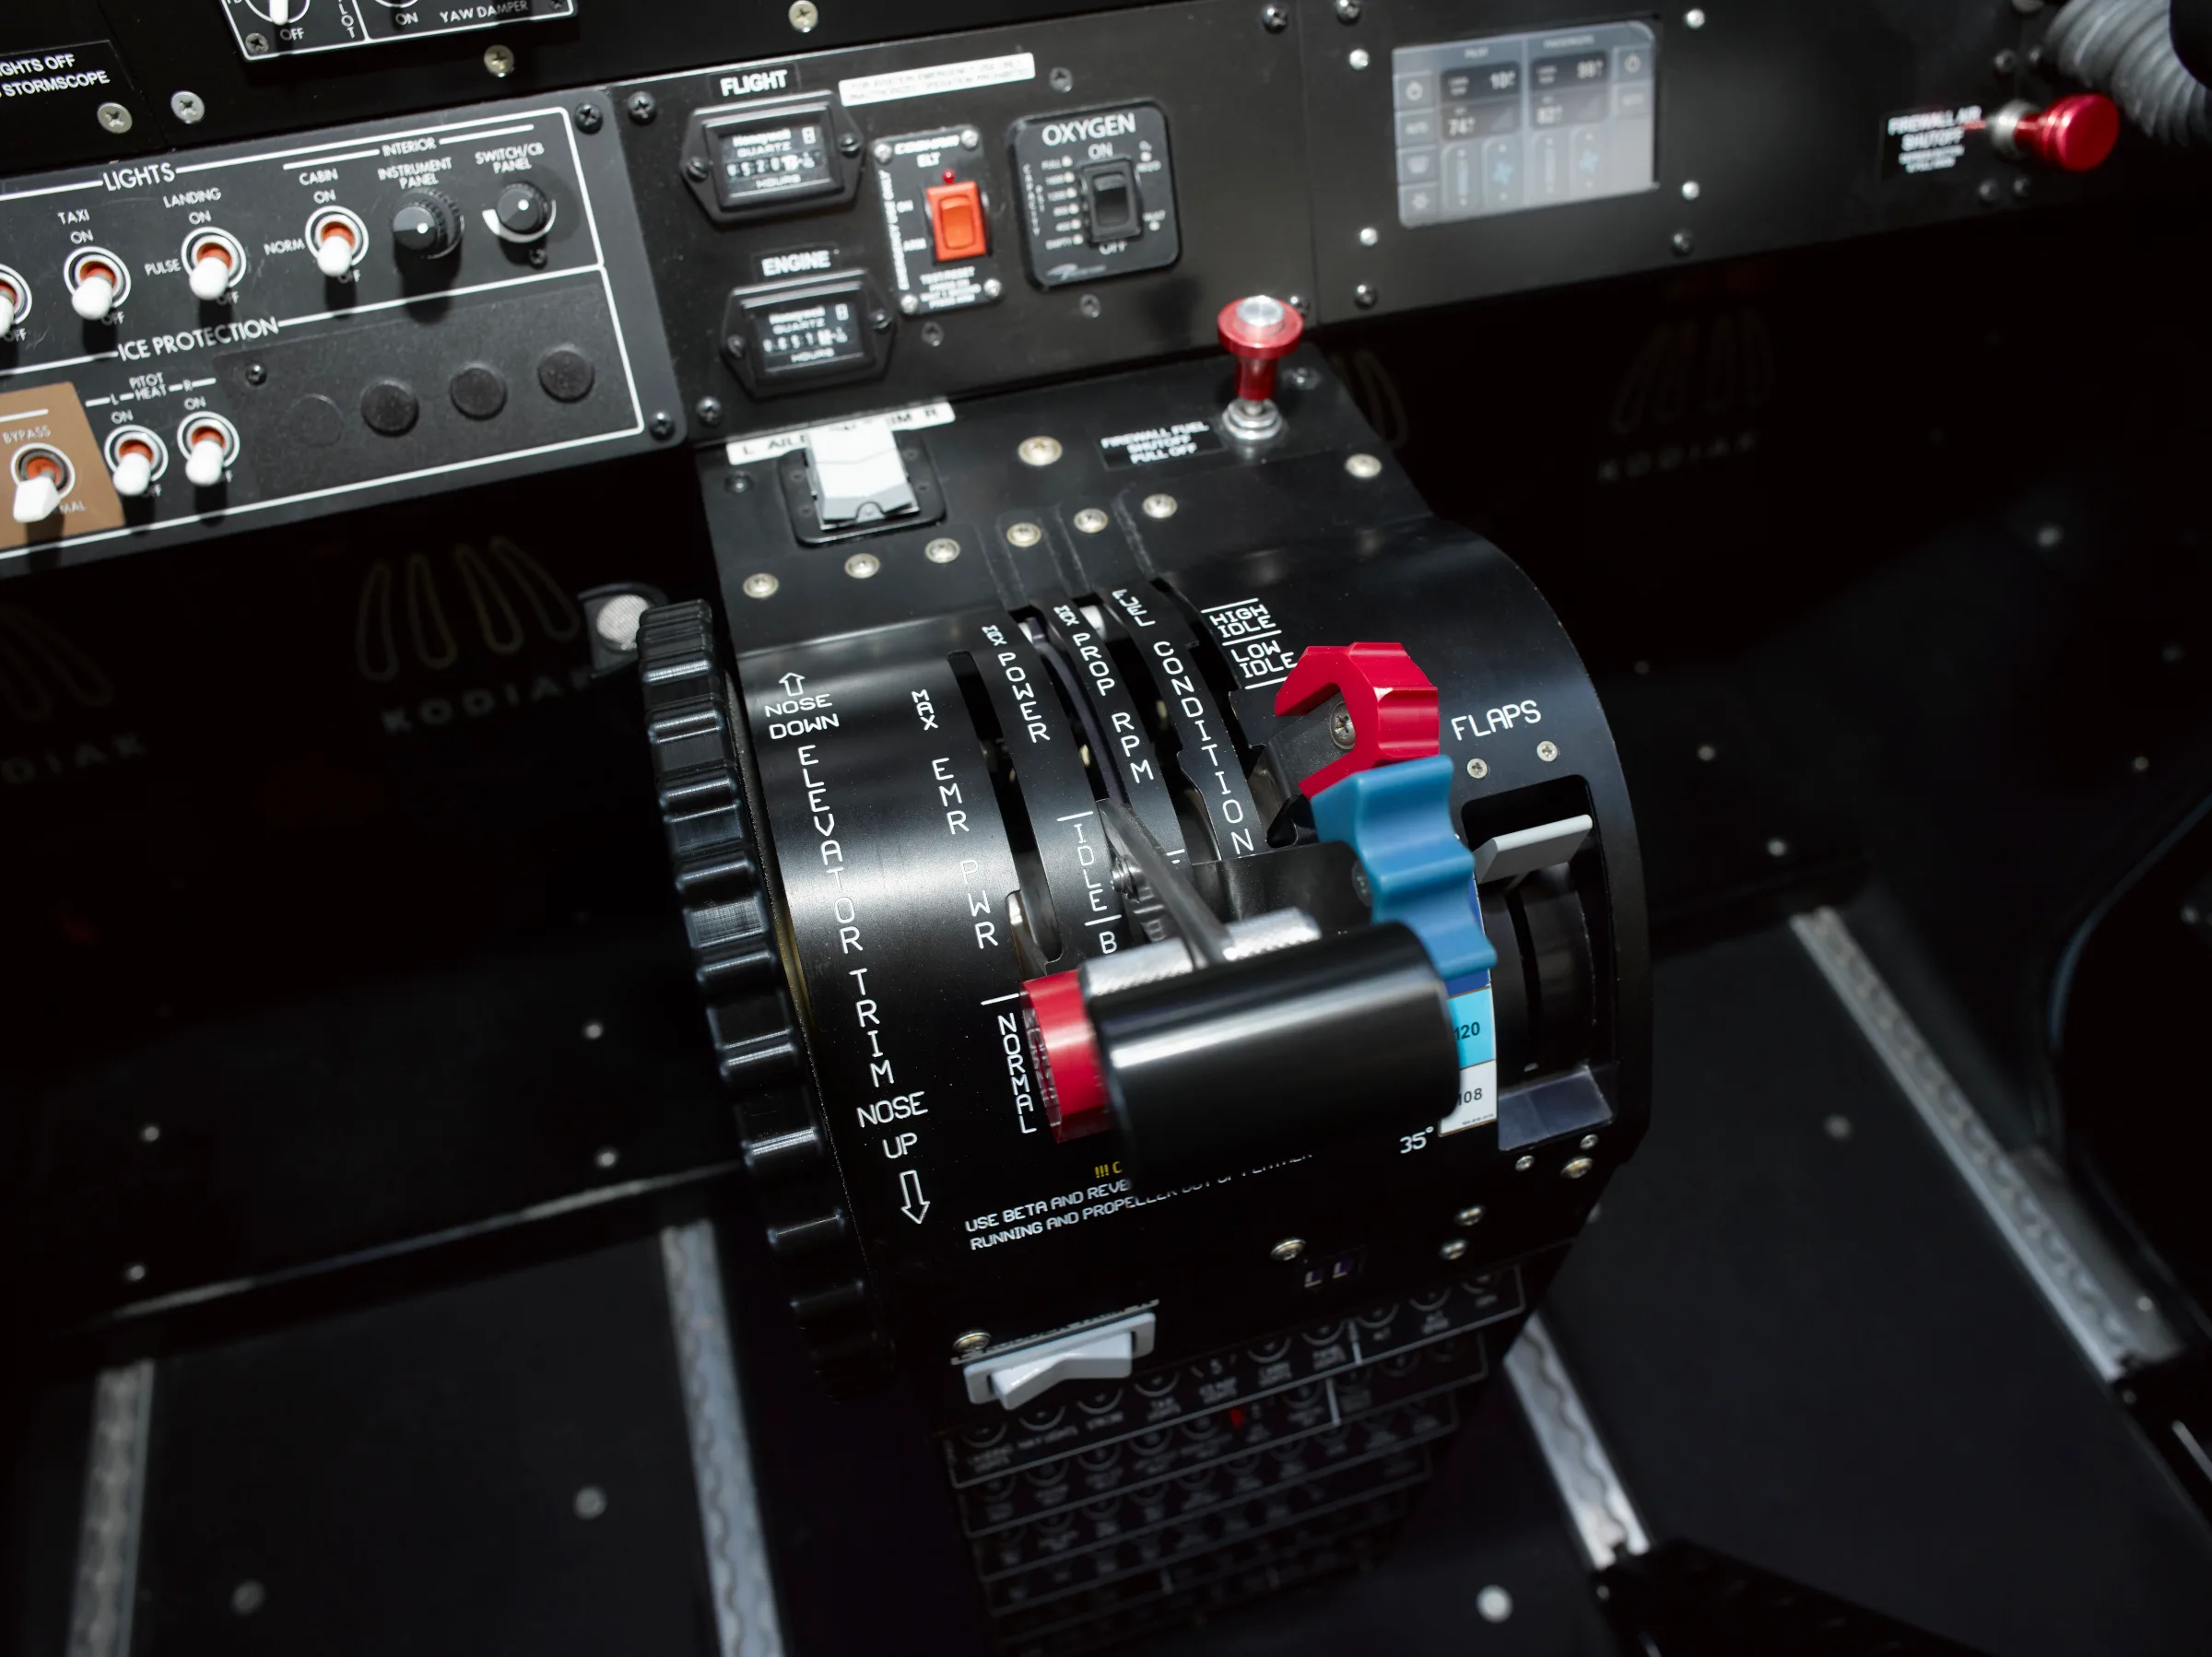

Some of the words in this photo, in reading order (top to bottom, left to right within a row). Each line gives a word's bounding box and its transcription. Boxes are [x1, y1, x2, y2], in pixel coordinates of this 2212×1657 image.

[337, 0, 356, 39] LOT
[395, 13, 418, 26] ON
[440, 8, 476, 24] YAW
[477, 1, 529, 18] DAMPER
[280, 28, 305, 41] OFF
[0, 58, 44, 76] GHTS
[44, 53, 76, 70] OFF
[2, 70, 111, 97] STORMSCOPE
[720, 69, 788, 97] FLIGHT
[1041, 112, 1136, 146] OXYGEN
[382, 137, 438, 157] INTERIOR
[475, 142, 546, 165] SWITCH/CB
[1088, 142, 1113, 160] ON
[102, 162, 177, 192] LIGHTS
[299, 168, 339, 186] CABIN
[378, 157, 453, 182] INSTRUMENT
[493, 157, 533, 174] PANEL
[399, 173, 440, 190] PANEL
[163, 187, 222, 209] LANDING
[313, 189, 336, 205] ON
[58, 209, 90, 226] TAXI
[189, 210, 212, 225] ON
[70, 229, 94, 245] ON
[264, 238, 306, 256] NORM
[145, 258, 182, 276] PULSE
[761, 250, 831, 276] ENGINE
[118, 342, 151, 362] ICE
[152, 316, 279, 356] PROTECTION
[129, 371, 164, 389] PITOT
[135, 383, 168, 401] HEAT
[184, 396, 207, 411] ON
[111, 409, 134, 425] ON
[2, 424, 52, 445] BYPASS
[1130, 448, 1170, 464] PULL
[1168, 442, 1197, 457] OFF
[1209, 604, 1269, 627] HIGH
[1218, 615, 1277, 639] IDLE
[1230, 640, 1281, 664] LOW
[1240, 652, 1299, 678] IDLE
[765, 693, 832, 718] NOSE
[997, 652, 1051, 743] POWER
[1072, 632, 1115, 696] PROP
[1112, 712, 1154, 783] RPM
[769, 713, 840, 739] DOWN
[1451, 699, 1542, 741] FLAPS
[1153, 640, 1254, 855] CONDITION
[912, 689, 938, 730] MAX
[932, 758, 970, 835] EMR
[960, 859, 999, 949] PWR
[1074, 823, 1108, 912] IDLE
[797, 745, 864, 954] ELEVATOR
[849, 968, 894, 1087] TRIM
[1453, 1021, 1480, 1041] 120
[997, 1012, 1037, 1134] NORMAL
[856, 1091, 928, 1128] NOSE
[882, 1133, 918, 1158] UP
[1400, 1126, 1434, 1154] 35°
[965, 1214, 999, 1232] USE
[1003, 1201, 1048, 1224] BETA
[1052, 1191, 1084, 1211] AND
[971, 1222, 1043, 1251] RUNNING
[1047, 1211, 1079, 1230] AND
